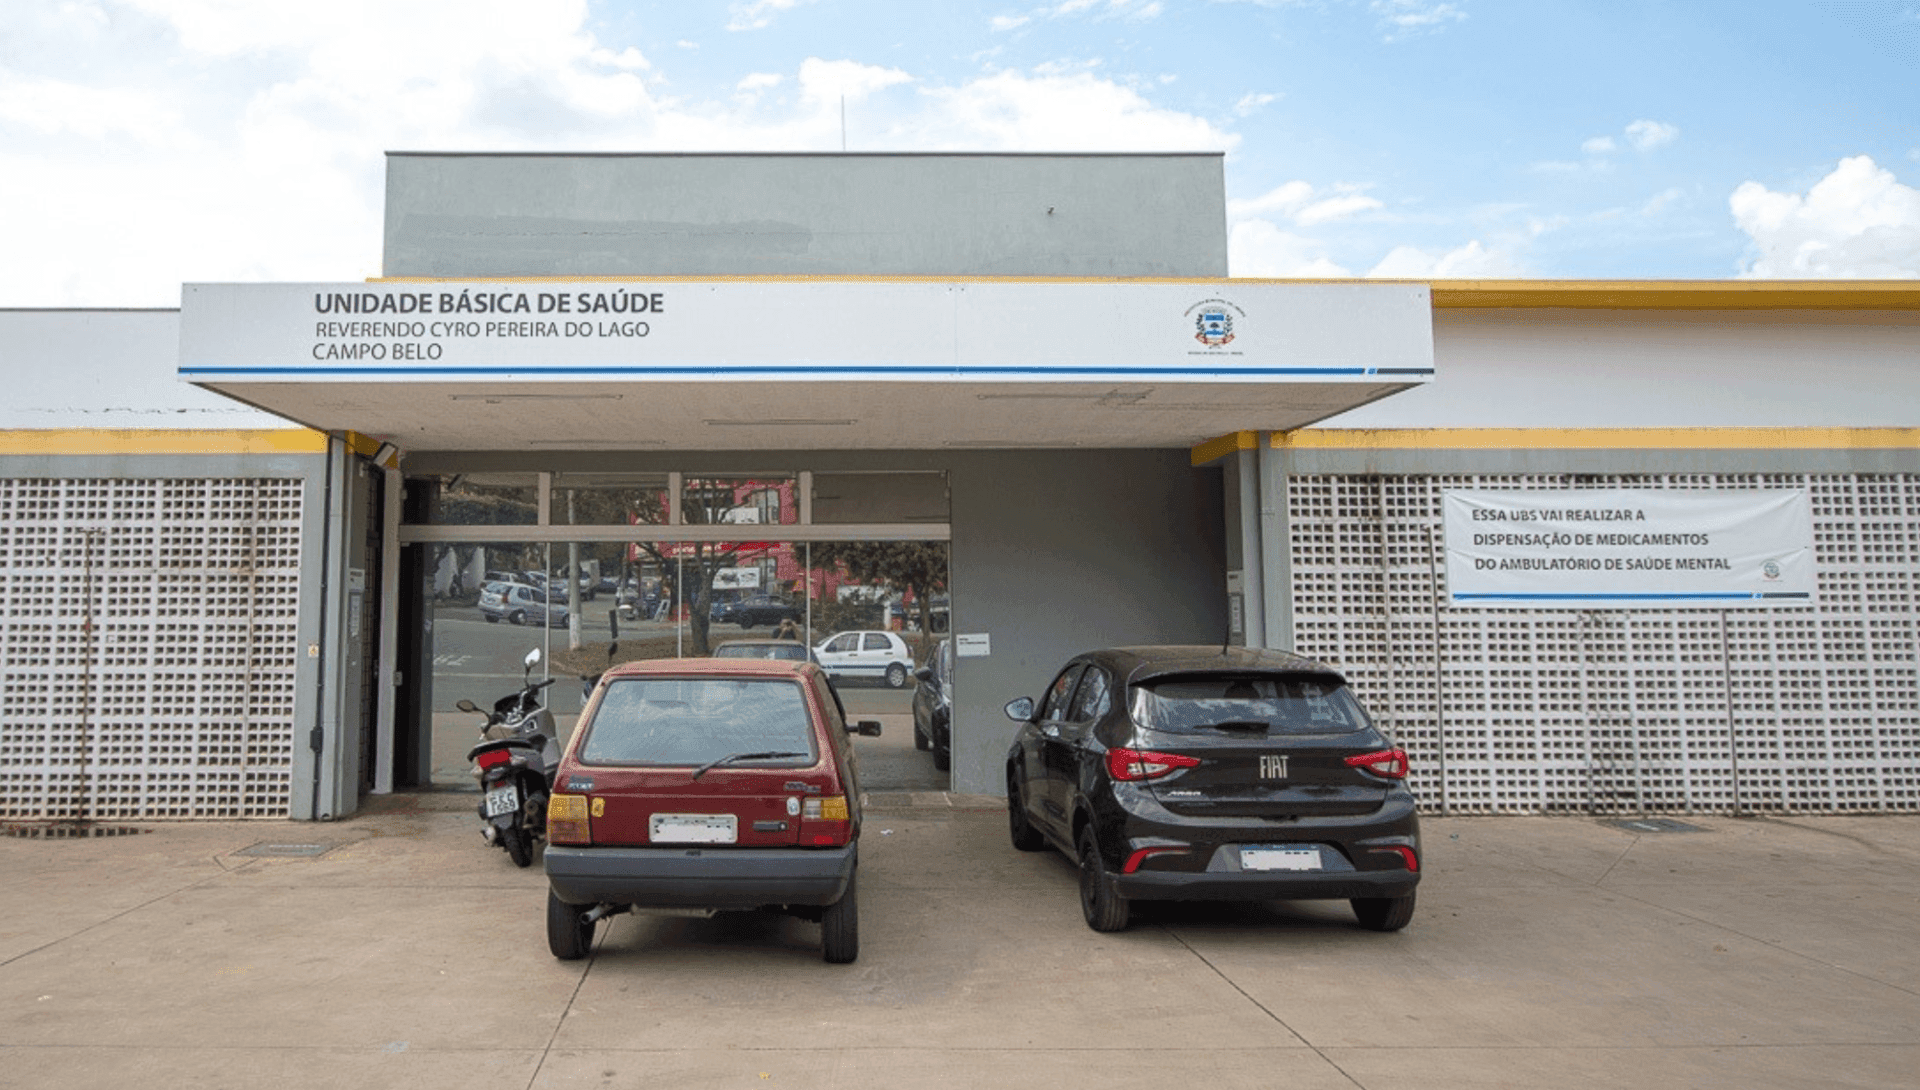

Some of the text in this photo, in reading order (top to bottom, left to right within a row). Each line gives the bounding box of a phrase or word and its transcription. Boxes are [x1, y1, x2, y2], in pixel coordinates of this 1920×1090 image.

[315, 289, 664, 313] UNIDADE BÁSICA DE SAÚDE
[316, 322, 650, 338] REVERENDO CYRO PEREIRA DO LAGO
[313, 343, 442, 360] CAMPO BELO
[1472, 509, 1645, 522] ESSA UBS VAI REALIZAR A
[1474, 532, 1709, 549] DISPENSAÇÃO DE MEDICAMENTOS
[1475, 556, 1731, 571] DO AMBULATÓRIO DE SAÚDE MENTAL
[1260, 755, 1289, 779] FIAT
